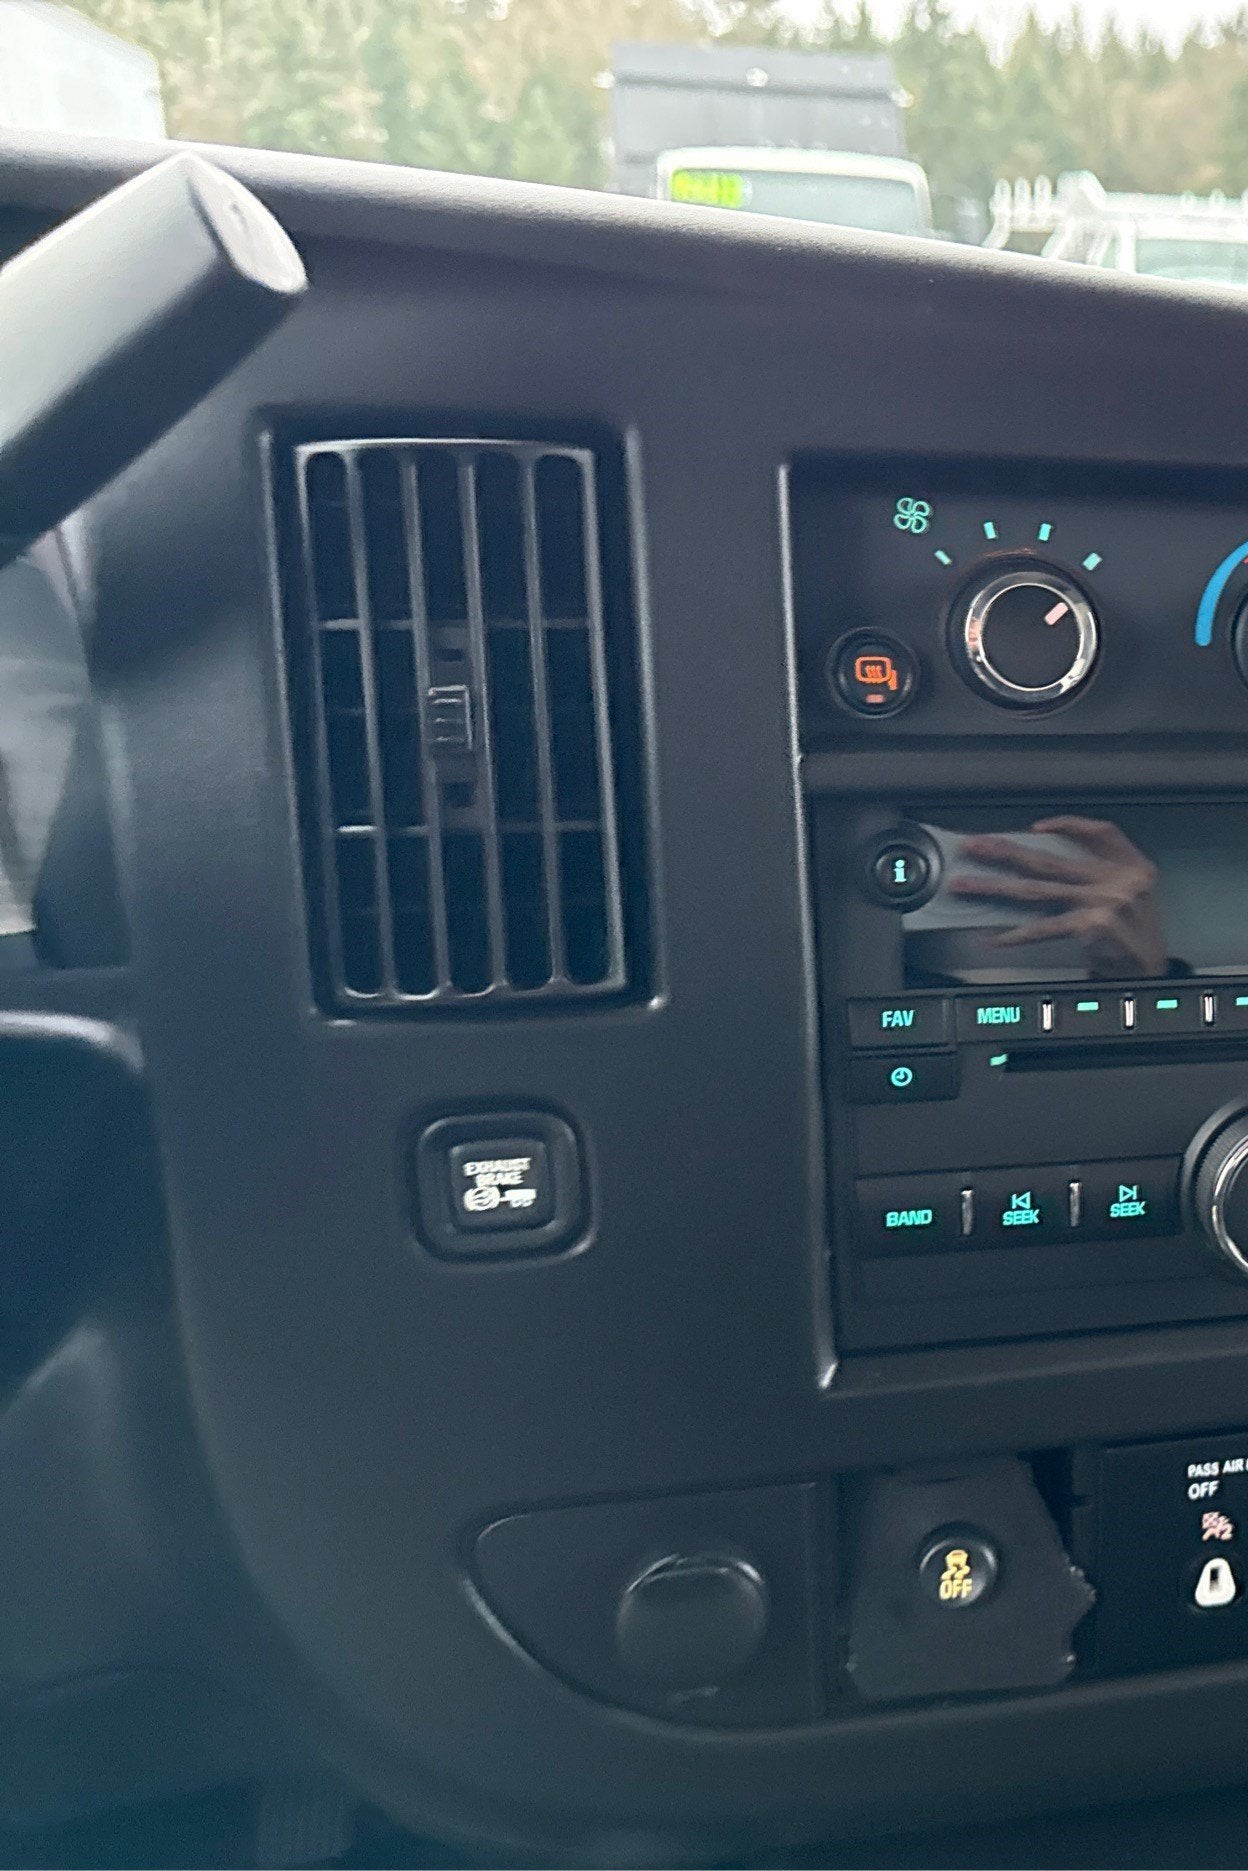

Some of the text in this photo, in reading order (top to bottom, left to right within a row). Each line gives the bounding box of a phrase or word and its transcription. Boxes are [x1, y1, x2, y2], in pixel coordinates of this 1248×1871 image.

[882, 1009, 915, 1028] FAV
[977, 1006, 1021, 1025] MENU
[885, 1209, 933, 1227] BAND
[1002, 1208, 1040, 1226] SEEK
[1109, 1200, 1146, 1218] SEEK
[1187, 1461, 1220, 1478] PASS
[1222, 1457, 1244, 1474] AIR
[1187, 1480, 1219, 1500] OFF
[939, 1578, 973, 1600] OFF
